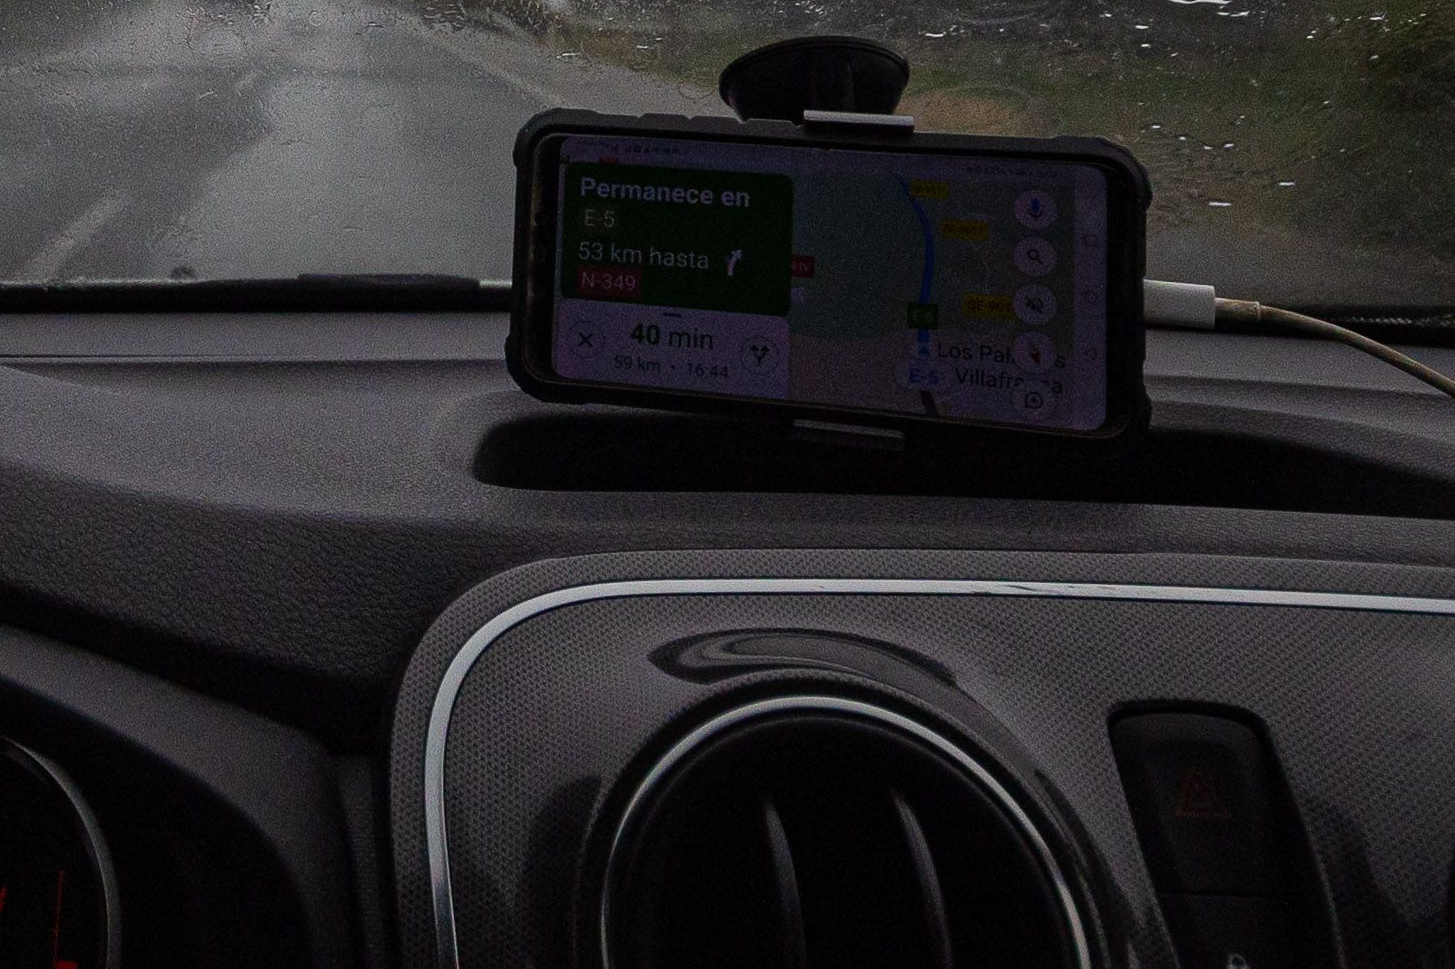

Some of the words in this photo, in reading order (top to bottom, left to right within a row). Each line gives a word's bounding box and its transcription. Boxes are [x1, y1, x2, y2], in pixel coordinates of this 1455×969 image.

[579, 176, 715, 206] Permanece
[721, 189, 751, 208] en
[583, 209, 616, 229] E-5
[578, 241, 604, 262] 53
[610, 243, 643, 265] km
[649, 246, 710, 270] hasta
[580, 272, 637, 291] N-349
[630, 323, 661, 345] 40
[668, 327, 714, 350] min
[937, 342, 973, 361] Los
[614, 355, 634, 371] 59
[637, 356, 661, 373] km
[909, 369, 939, 385] E-5
